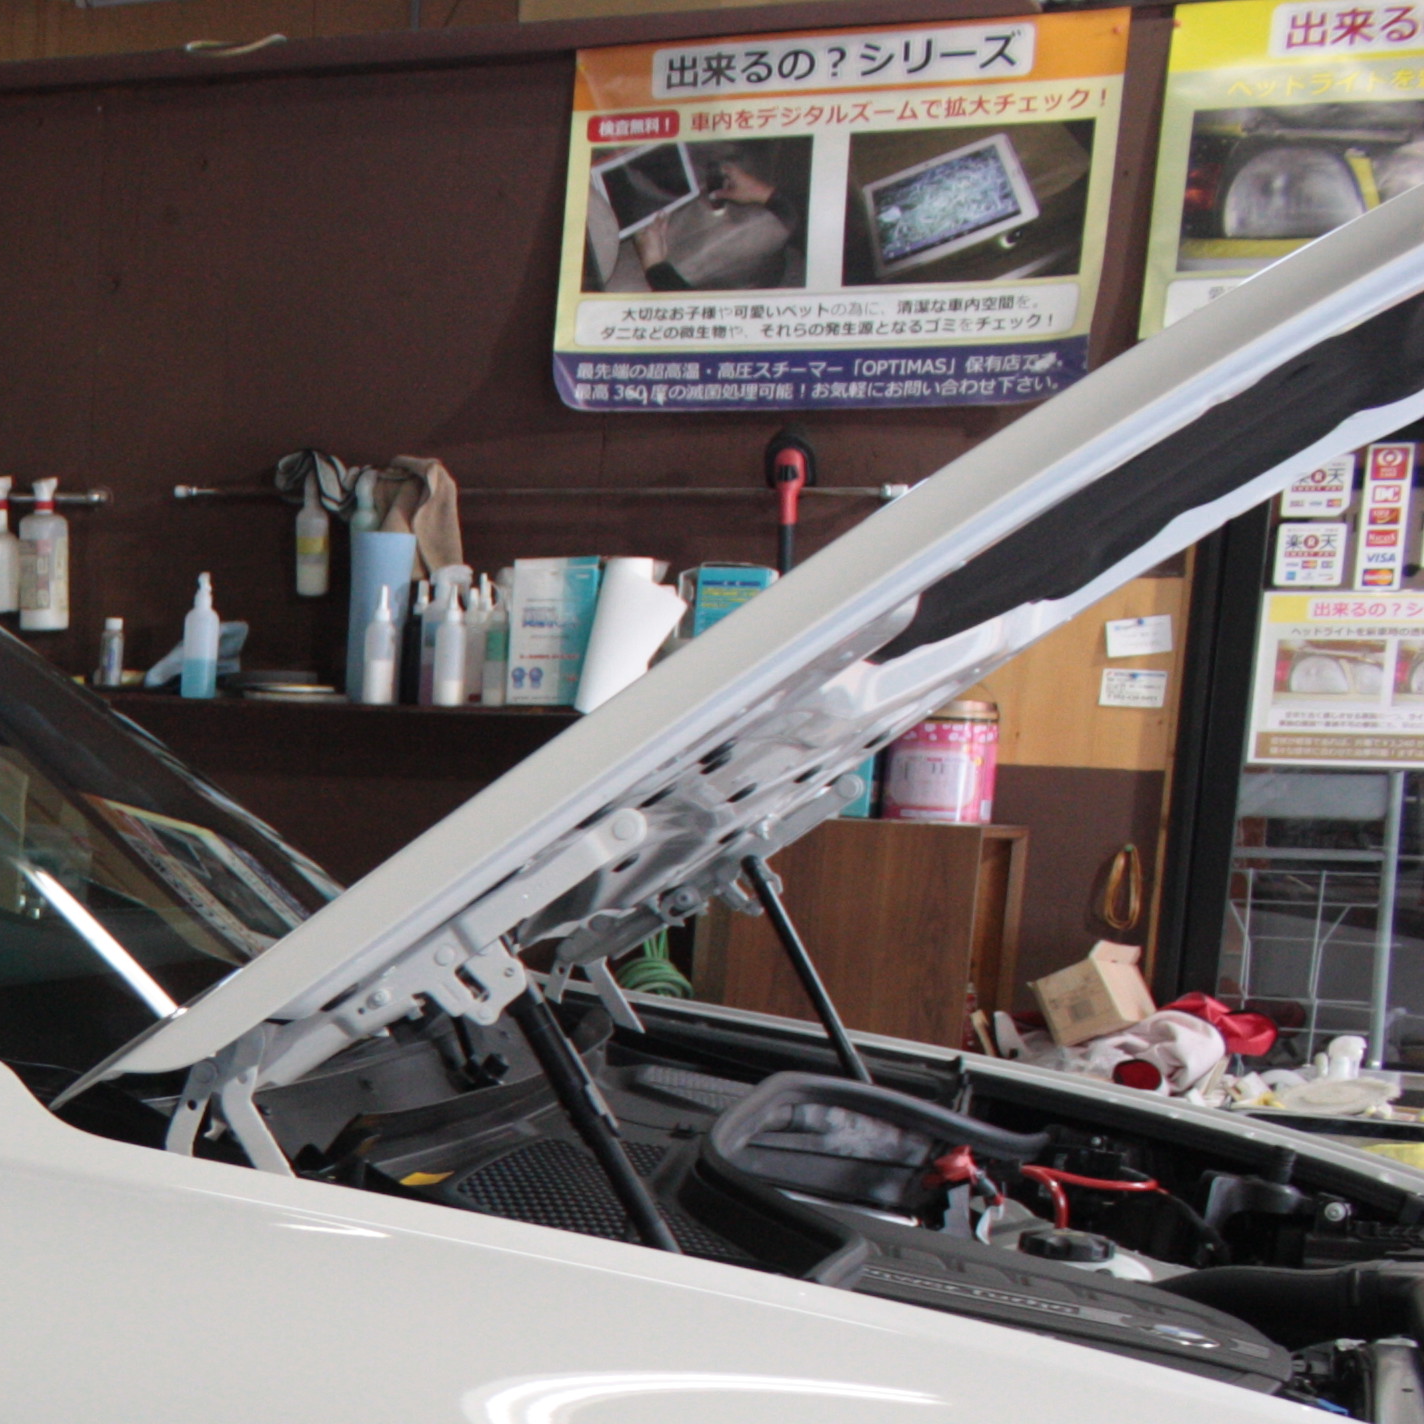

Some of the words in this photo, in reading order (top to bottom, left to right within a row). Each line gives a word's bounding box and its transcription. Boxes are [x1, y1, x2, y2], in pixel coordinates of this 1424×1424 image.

[665, 29, 1022, 91] 出来るの？シリーズ
[1366, 554, 1396, 563] VISA
